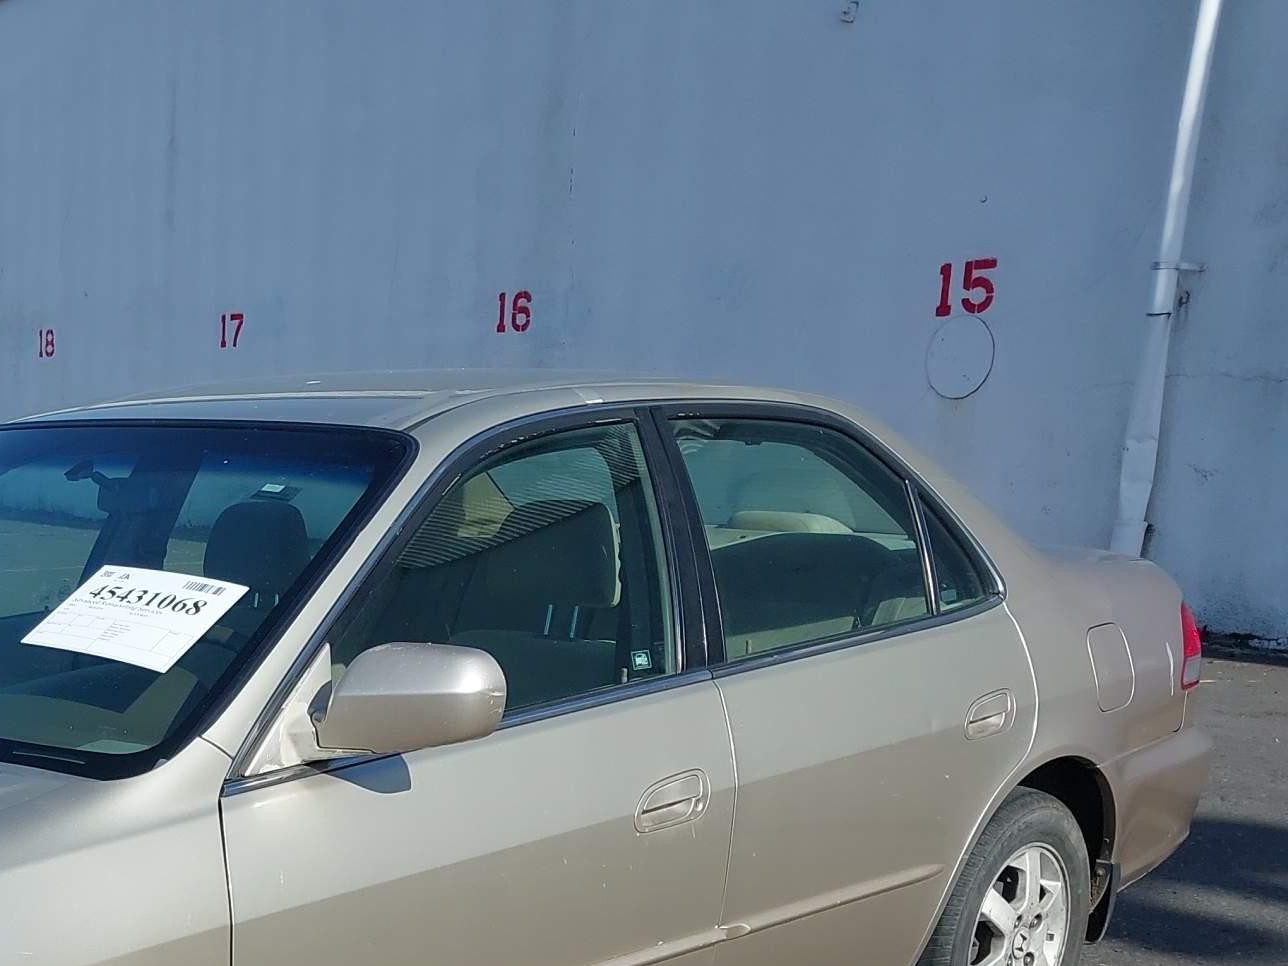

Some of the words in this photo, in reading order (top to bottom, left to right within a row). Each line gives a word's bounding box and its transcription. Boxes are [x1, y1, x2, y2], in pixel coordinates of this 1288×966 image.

[934, 256, 1000, 320] 15
[218, 310, 246, 350] 17
[493, 288, 533, 336] 16
[38, 328, 56, 359] 18
[89, 584, 208, 616] 45431068
